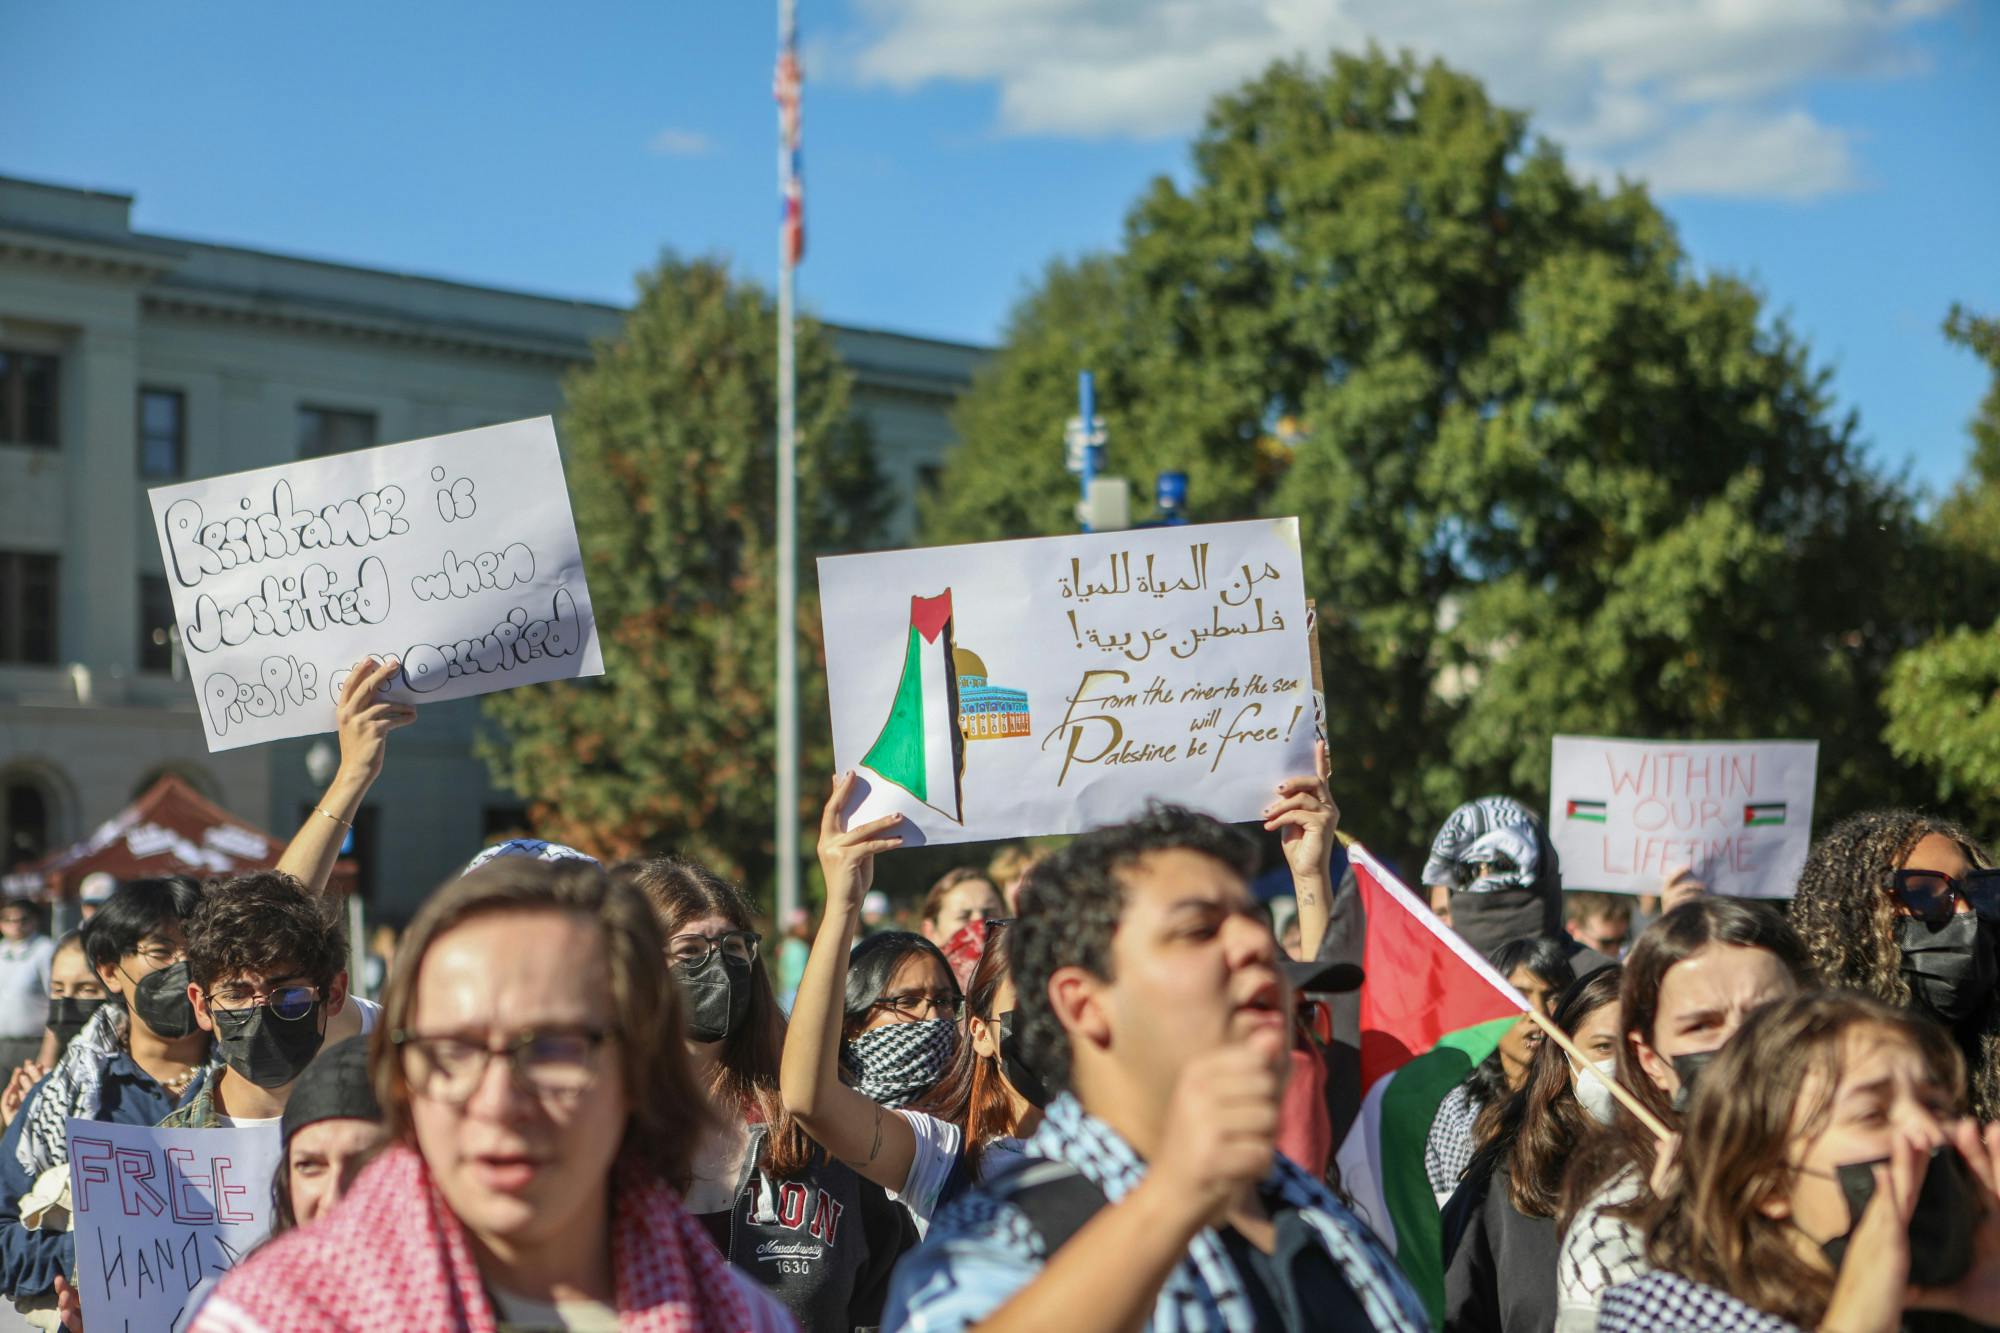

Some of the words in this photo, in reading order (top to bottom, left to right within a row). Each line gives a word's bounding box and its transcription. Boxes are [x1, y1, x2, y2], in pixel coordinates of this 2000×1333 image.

[165, 478, 409, 587] Resistance
[431, 466, 477, 522] is
[187, 556, 391, 652] Justified
[411, 542, 535, 601] when
[1220, 562, 1280, 606] من
[1170, 598, 1285, 659] فلسطين
[204, 655, 317, 736] People
[402, 588, 580, 693] Occupied
[1066, 670, 1138, 740] From
[1143, 676, 1174, 705] the
[1180, 682, 1225, 704] river
[1223, 678, 1240, 698] to
[1243, 674, 1268, 697] the
[1273, 678, 1298, 692] sea
[1190, 708, 1222, 732] will
[1042, 715, 1177, 787] Palestine
[1186, 738, 1208, 759] be
[1211, 703, 1303, 773] free!
[1605, 751, 1757, 798] WITHIN
[1632, 799, 1729, 832] OUR
[1603, 834, 1760, 876] LIFETIME
[72, 1136, 254, 1226] FREE
[776, 1260, 809, 1275] 1630
